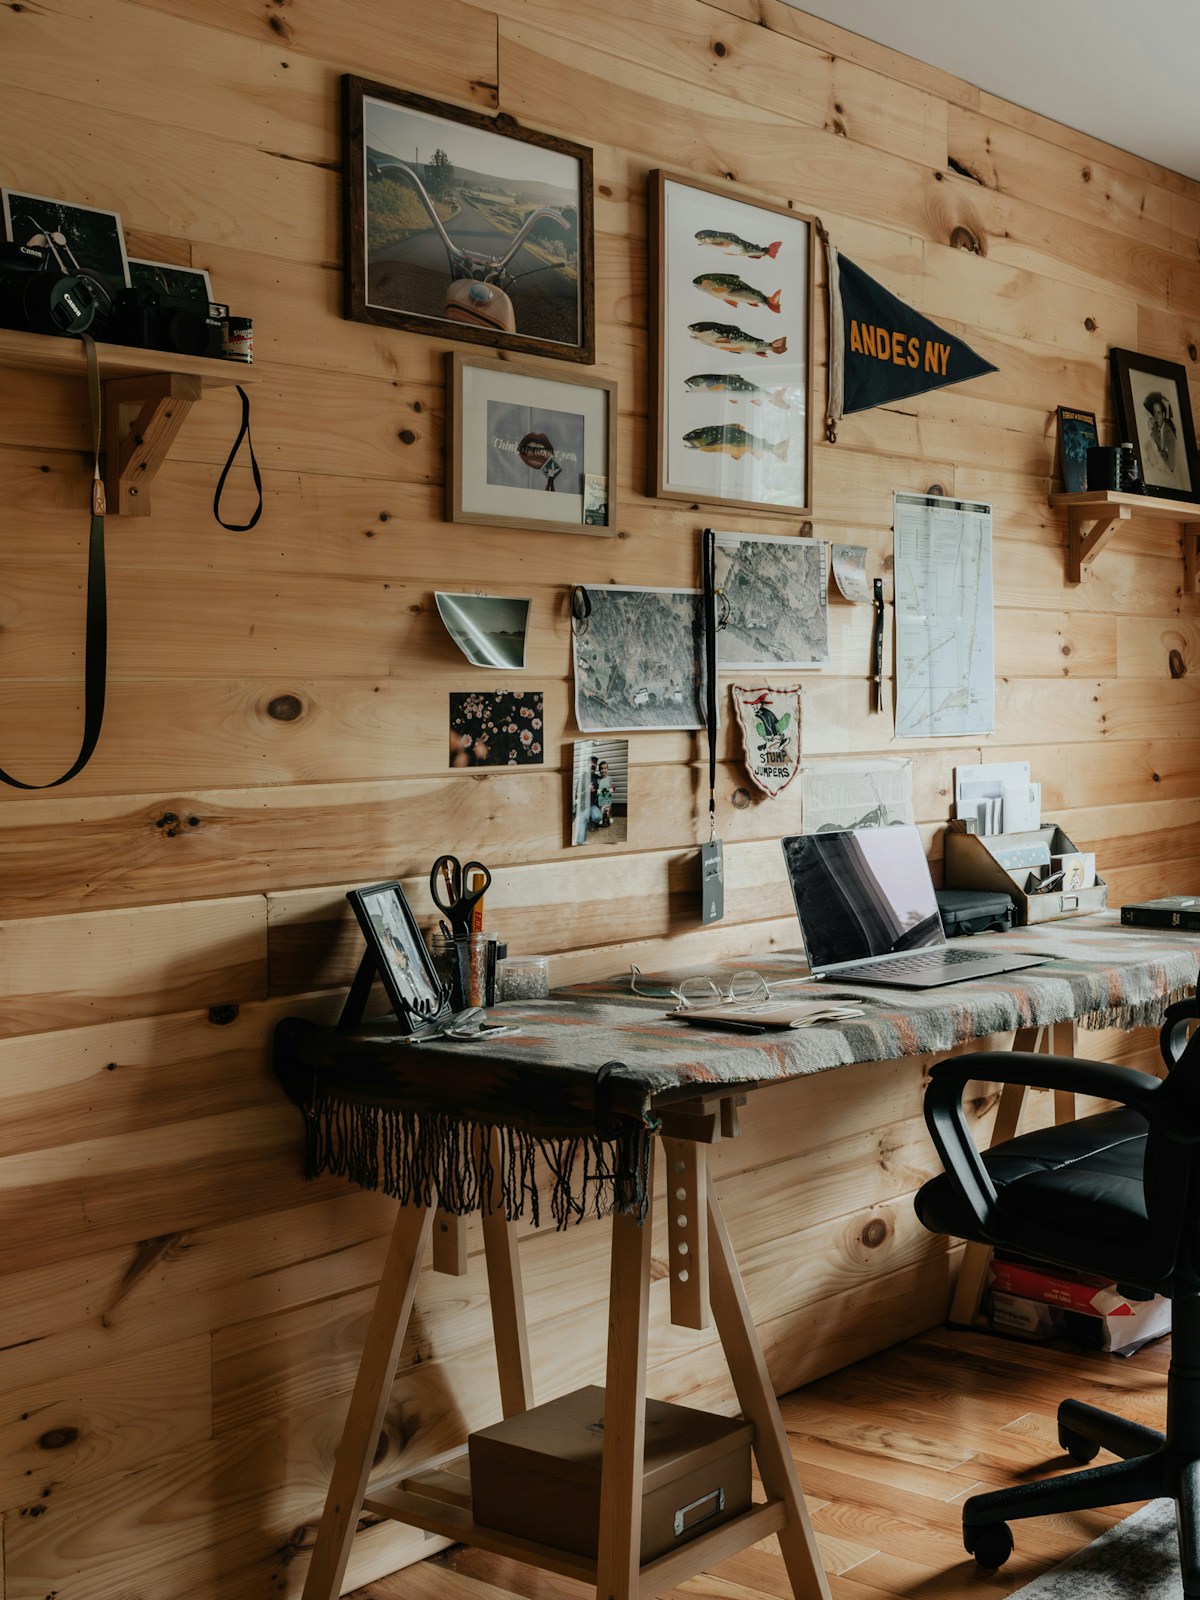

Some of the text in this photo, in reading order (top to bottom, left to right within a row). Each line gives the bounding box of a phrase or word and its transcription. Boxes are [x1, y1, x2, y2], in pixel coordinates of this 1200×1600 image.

[20, 246, 43, 258] Canon
[64, 293, 82, 317] Canon
[205, 318, 222, 327] Nikon
[849, 319, 953, 377] ANDES NY
[760, 750, 787, 763] STUMP
[754, 767, 790, 778] JUMPERS
